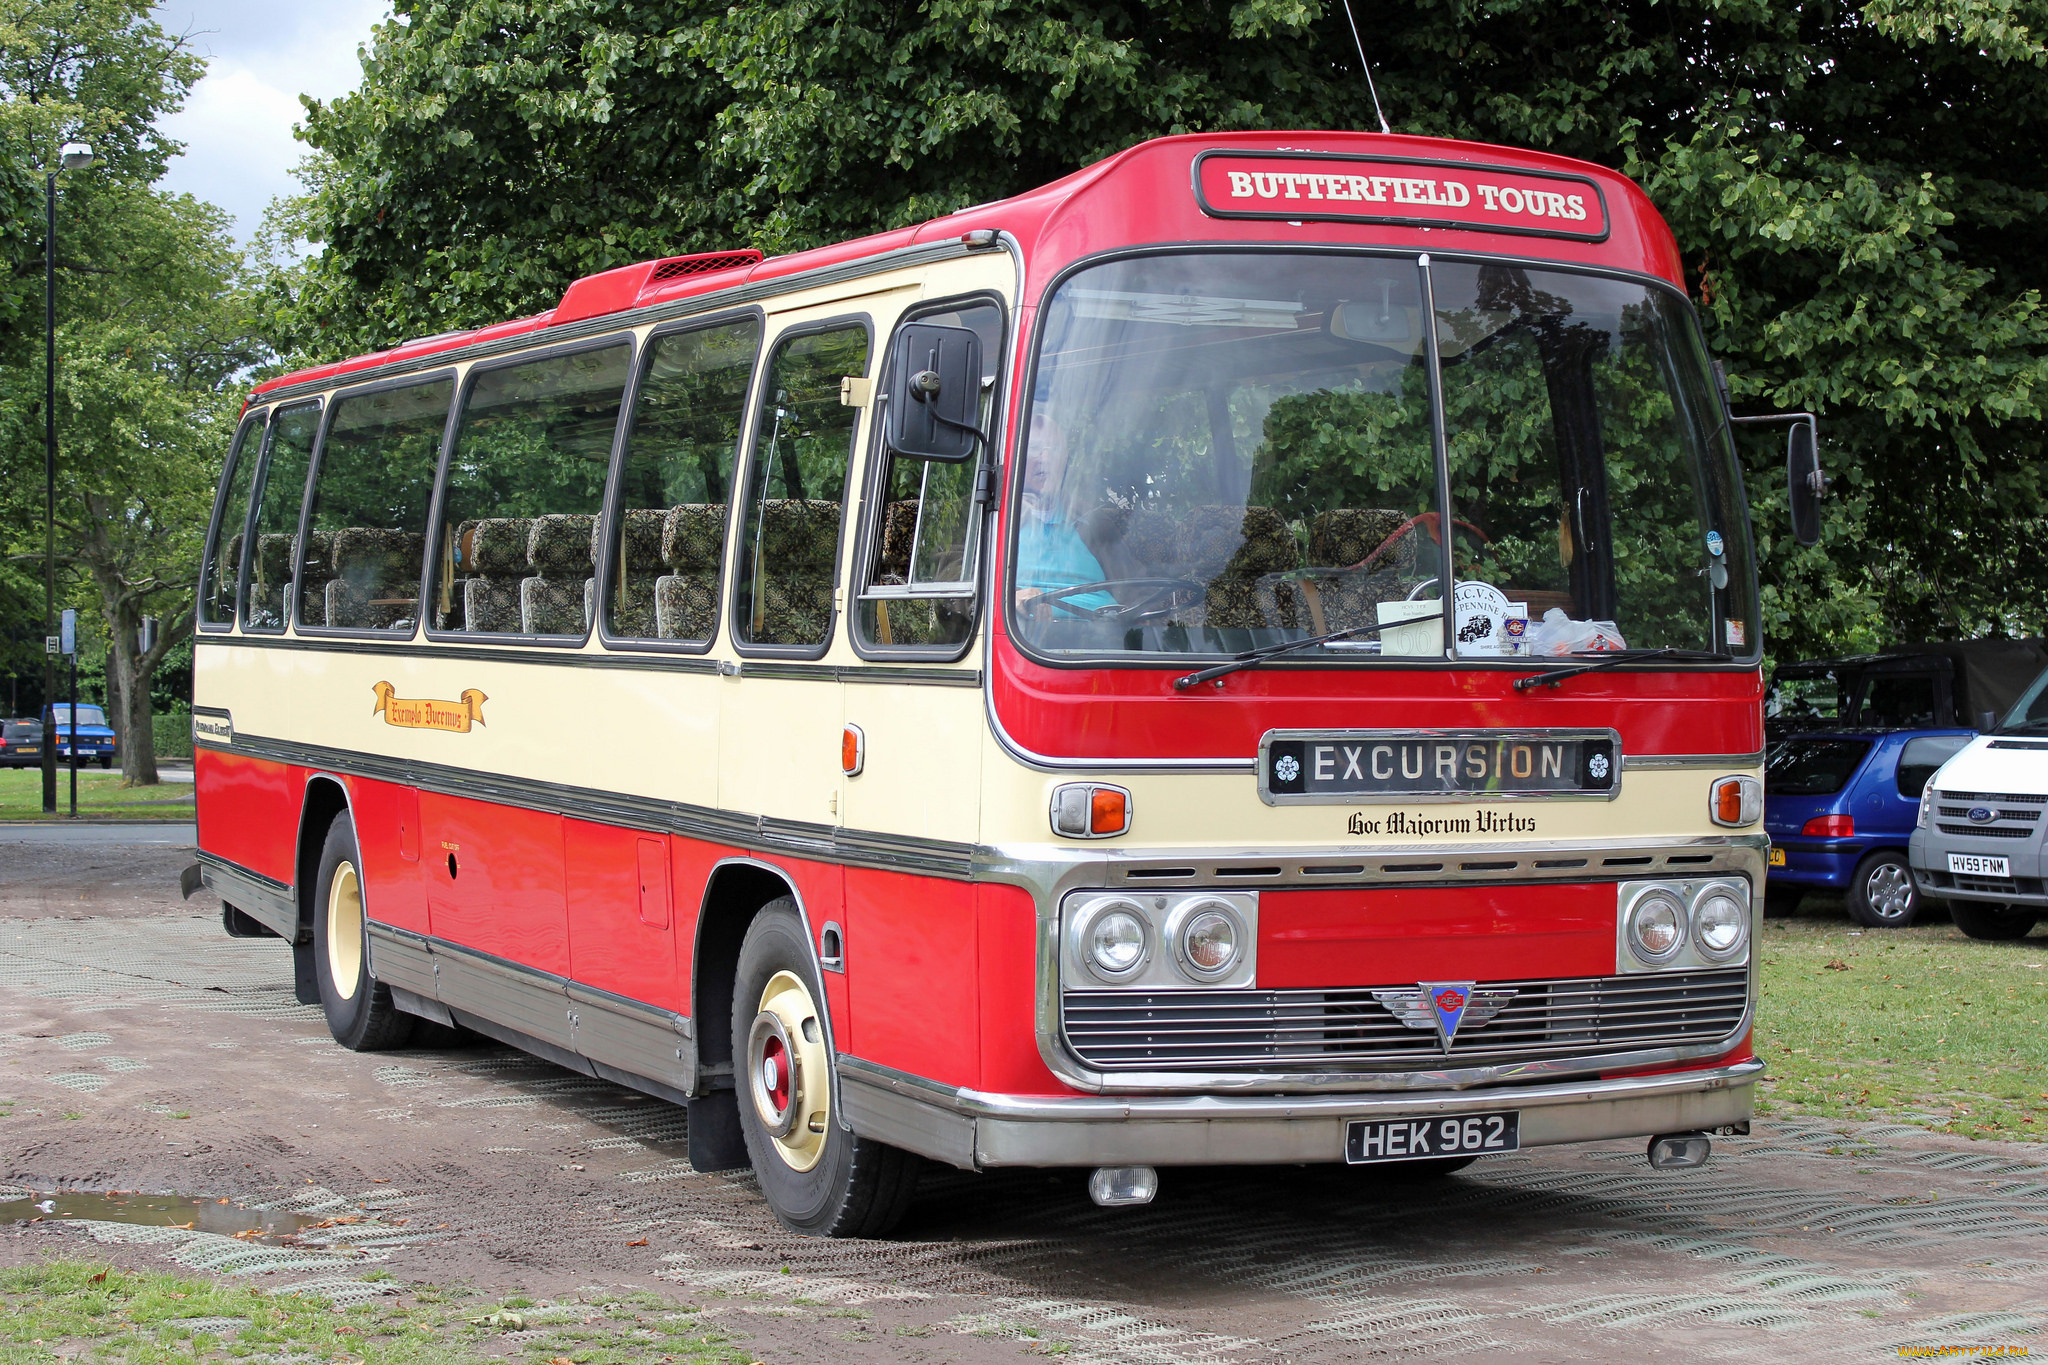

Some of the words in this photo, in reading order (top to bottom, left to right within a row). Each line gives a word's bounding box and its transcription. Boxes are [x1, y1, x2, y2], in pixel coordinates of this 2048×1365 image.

[1227, 171, 1470, 208] BUTTERFIELD
[1477, 184, 1587, 221] TOURS
[1397, 622, 1432, 656] 66
[1314, 745, 1563, 780] EXCURSION
[1347, 811, 1381, 835] Hoc
[1386, 811, 1471, 839] Majorum
[1475, 810, 1536, 833] Virtus
[1952, 856, 1980, 872] HV59
[1982, 859, 2004, 873] FNM
[1439, 996, 1462, 1006] AEC
[1363, 1121, 1431, 1157] HEK
[1440, 1116, 1505, 1151] 962
